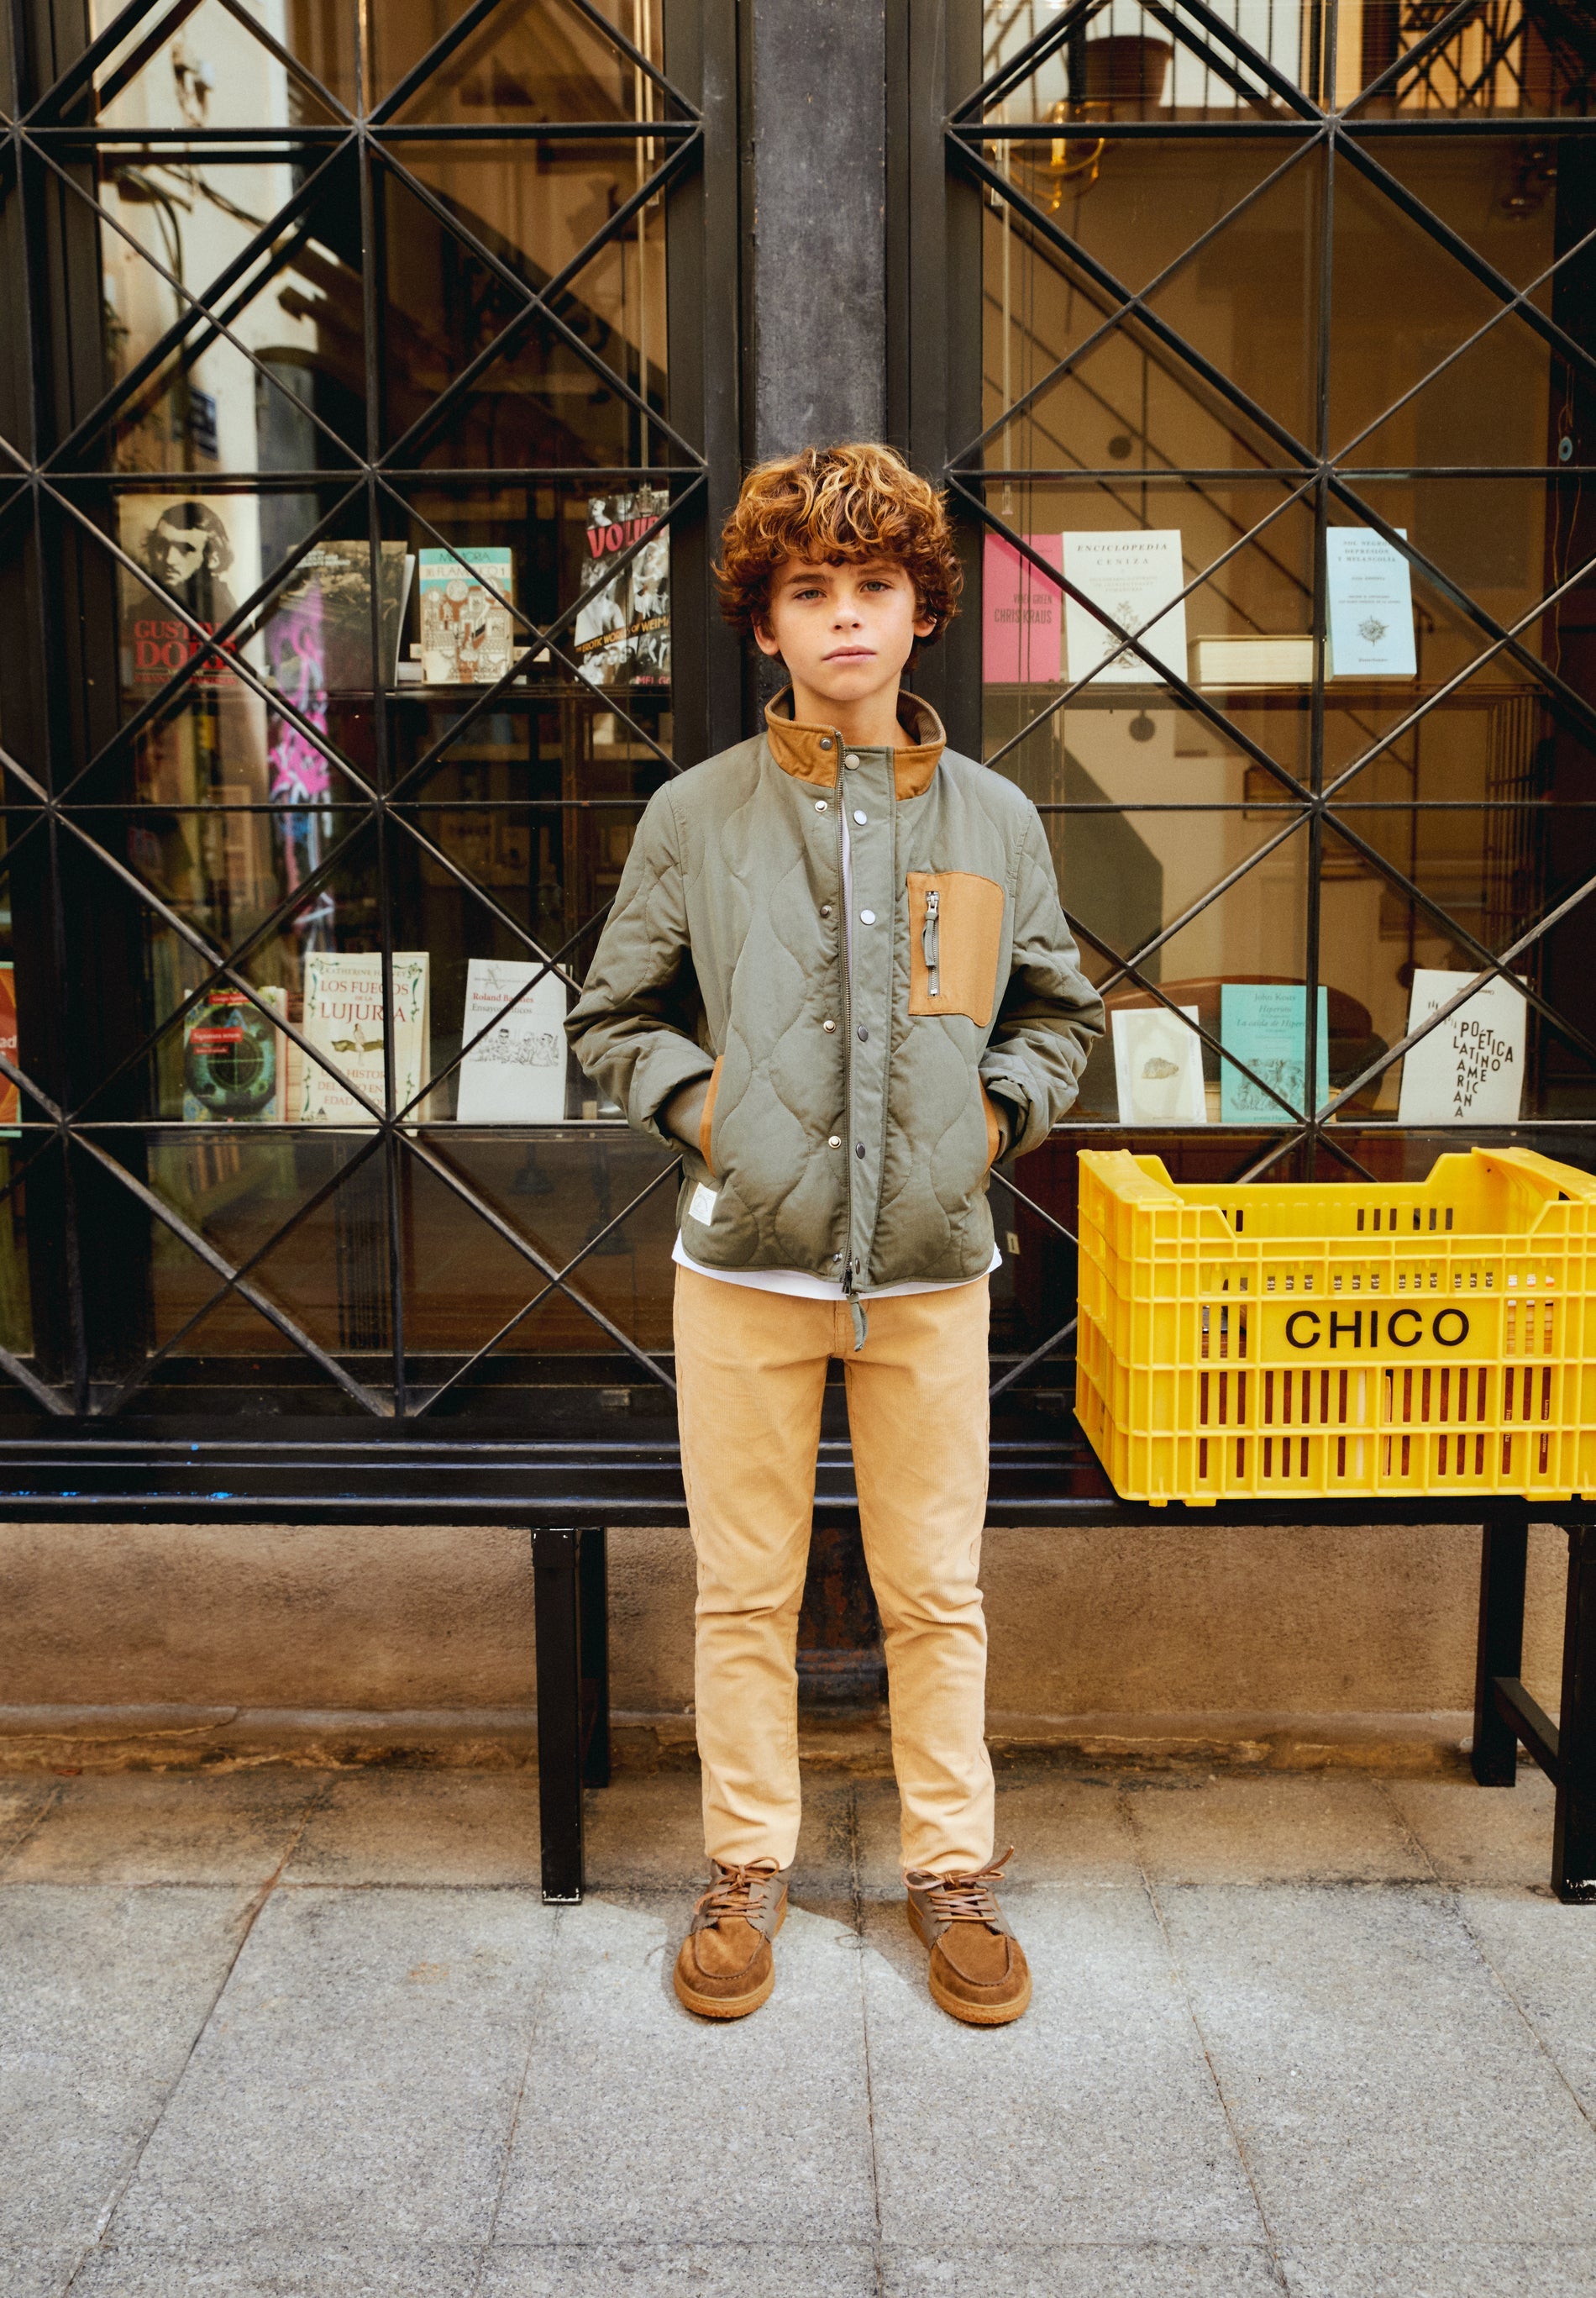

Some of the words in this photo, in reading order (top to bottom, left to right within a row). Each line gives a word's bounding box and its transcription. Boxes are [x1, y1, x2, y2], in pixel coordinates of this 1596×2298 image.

[1078, 544, 1168, 552] ENCICLOPEDIA
[437, 565, 499, 577] FLAMCO
[1033, 594, 1053, 604] GREEN
[995, 609, 1021, 623] CHRIS
[1023, 610, 1052, 623] KRAUS
[321, 980, 347, 992] LOS
[473, 993, 501, 1002] Roland
[321, 1002, 406, 1023] LUJURA
[1461, 1022, 1514, 1063] POÉTICA
[1453, 1036, 1501, 1071] LATINO
[318, 1081, 336, 1091] DEL
[370, 1084, 382, 1092] EN
[324, 1096, 353, 1105] EDAD
[1285, 1308, 1469, 1349] CHICO
